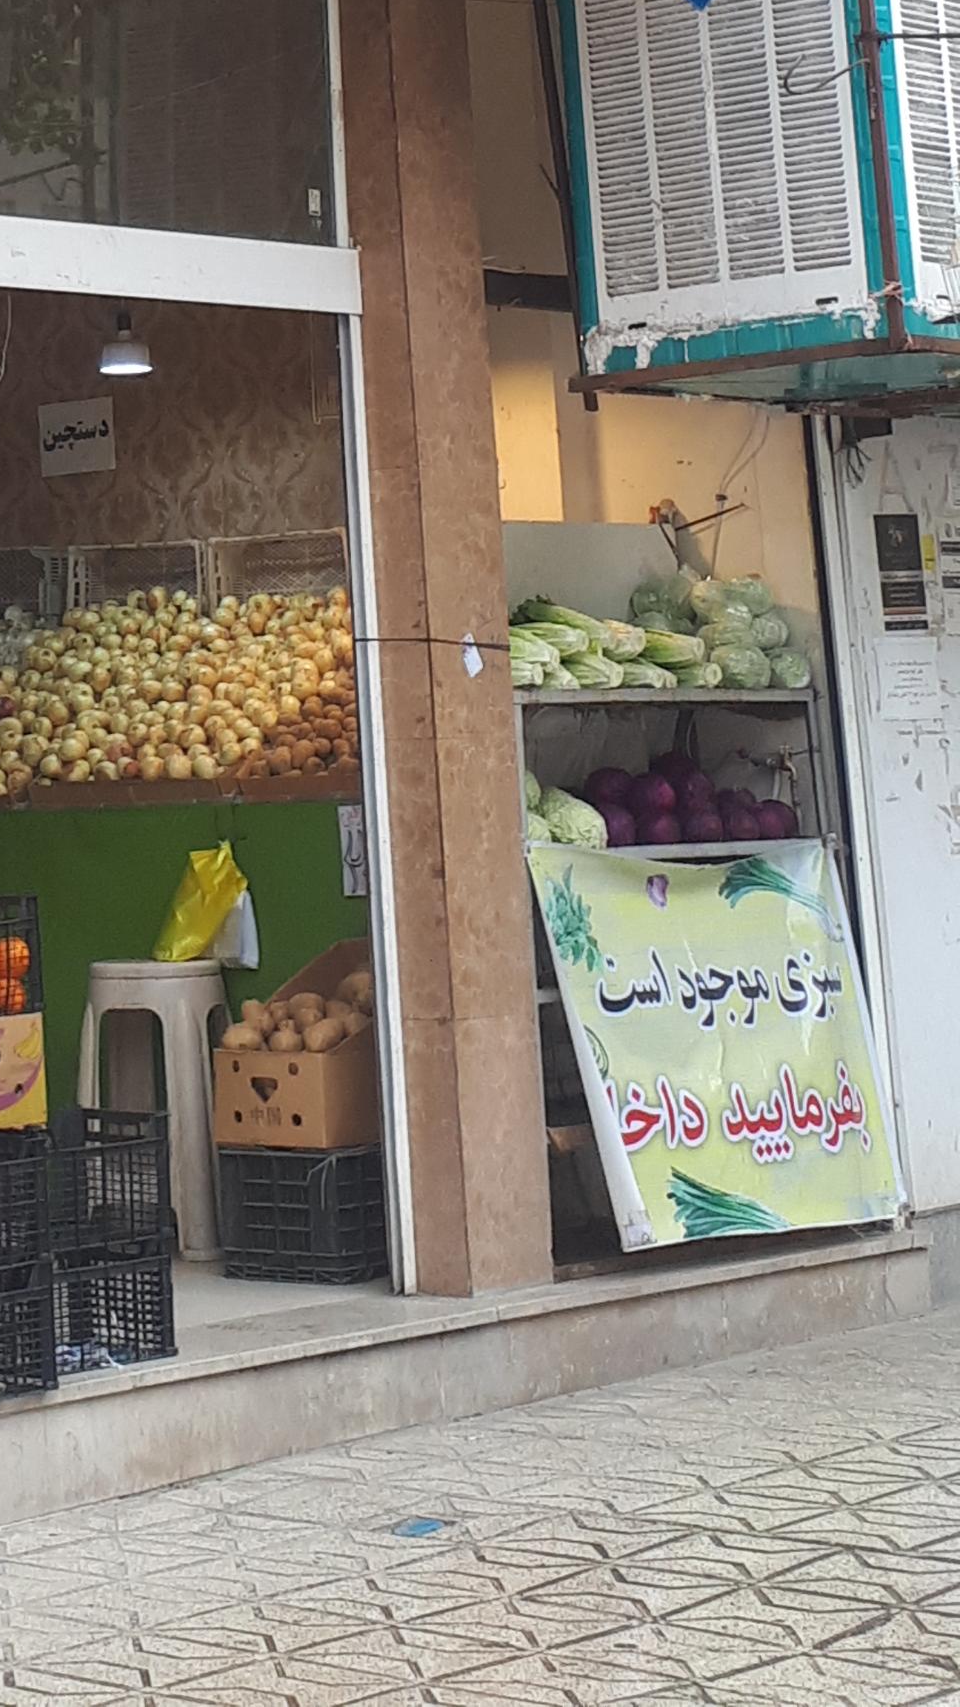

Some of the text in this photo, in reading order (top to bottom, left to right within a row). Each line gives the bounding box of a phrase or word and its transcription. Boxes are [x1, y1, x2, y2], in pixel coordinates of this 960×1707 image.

[43, 419, 109, 452] دستچین
[598, 947, 843, 1030] سبزی موجود است
[722, 1061, 874, 1165] بفرمایید
